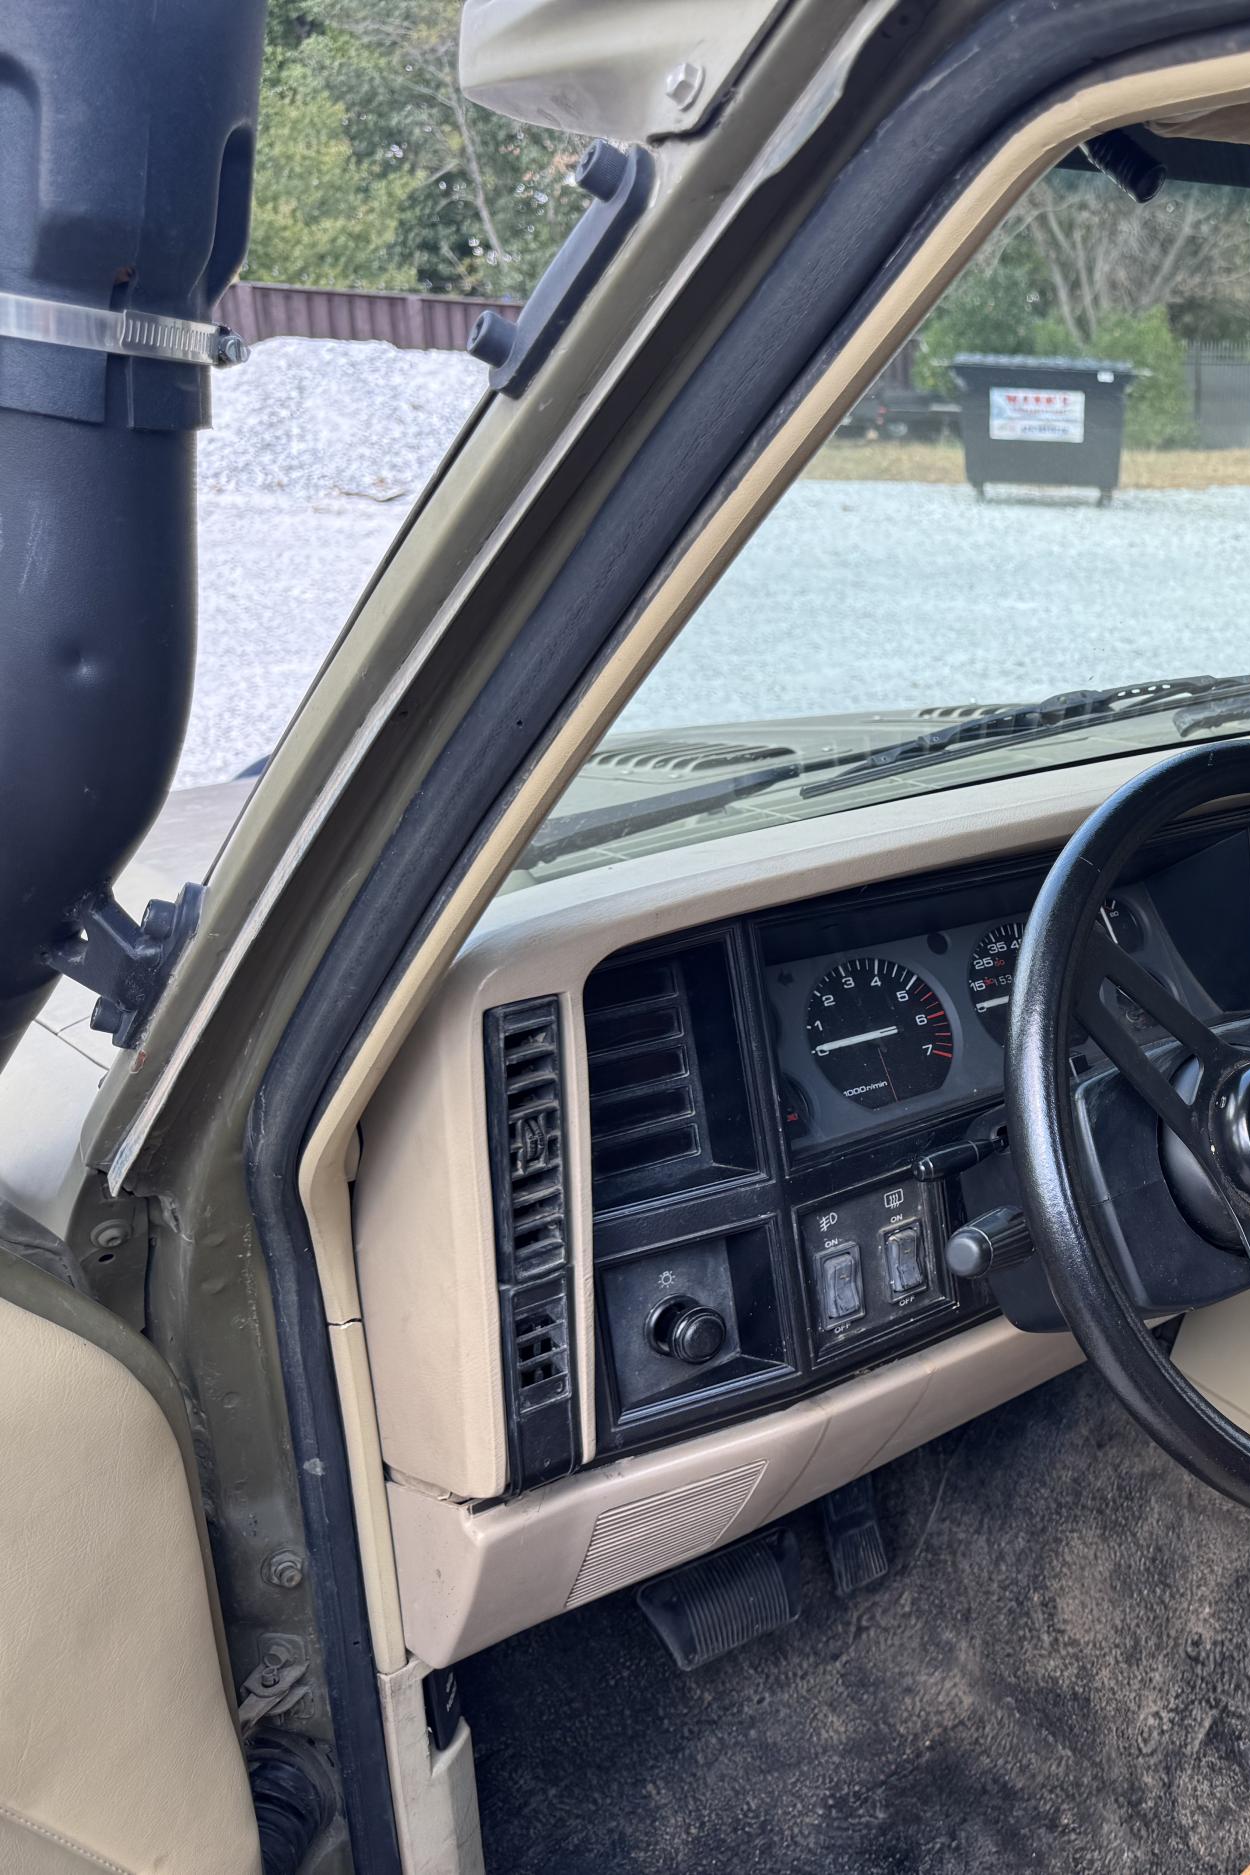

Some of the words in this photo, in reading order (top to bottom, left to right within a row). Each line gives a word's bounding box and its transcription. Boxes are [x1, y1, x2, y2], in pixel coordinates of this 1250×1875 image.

[987, 941, 1008, 955] 35
[1010, 939, 1022, 949] 4
[973, 956, 994, 970] 25
[841, 977, 856, 990] 3
[870, 976, 882, 988] 4
[970, 980, 986, 993] 15
[821, 994, 836, 1008] 2
[895, 990, 909, 1003] 5
[813, 1020, 824, 1032] 1
[915, 1014, 928, 1026] 6
[922, 1044, 933, 1056] 7
[890, 1213, 904, 1224] ON
[824, 1239, 839, 1248] ON
[899, 1296, 915, 1307] OFF
[834, 1324, 850, 1334] OFF
